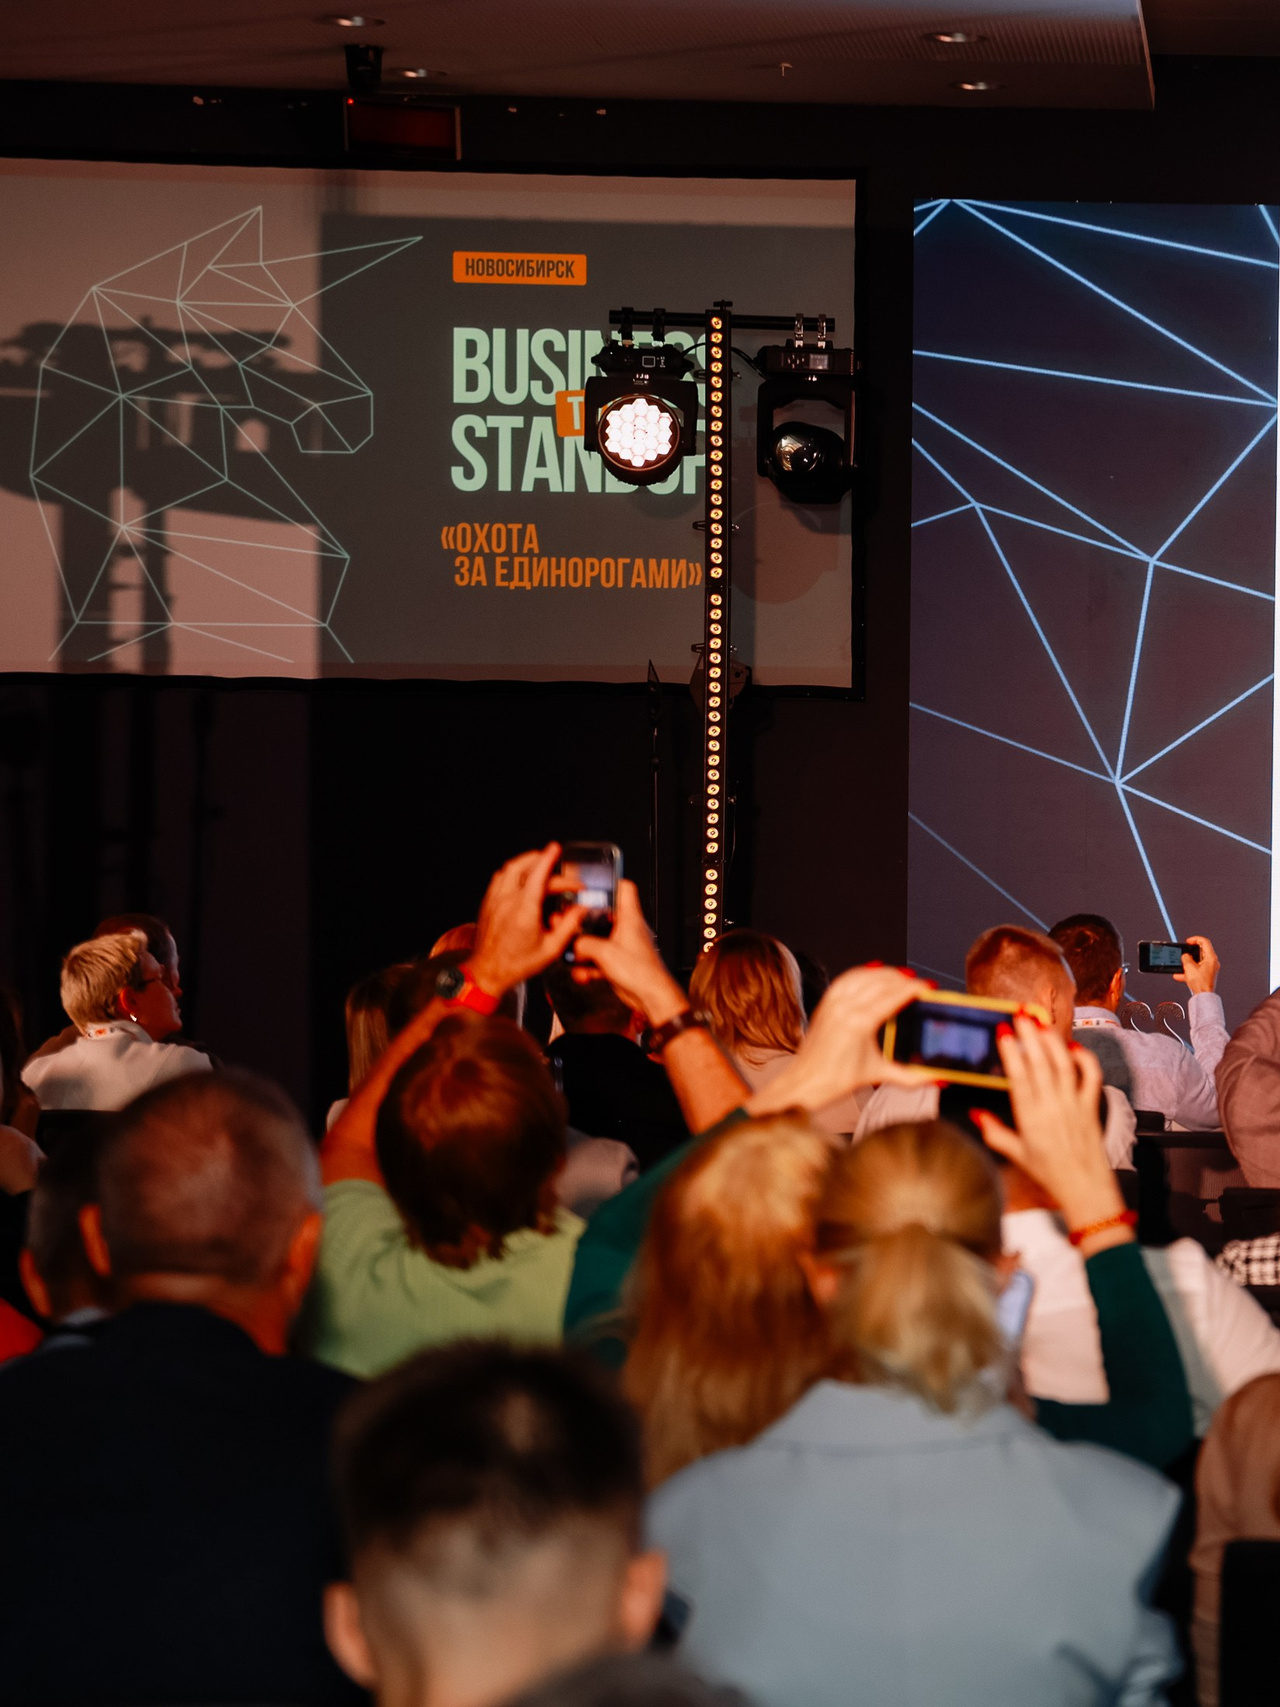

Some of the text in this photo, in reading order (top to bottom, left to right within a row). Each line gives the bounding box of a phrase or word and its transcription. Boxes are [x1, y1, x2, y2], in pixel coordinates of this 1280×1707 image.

[464, 257, 576, 279] НОВОСИБИРСК
[441, 522, 540, 554] «ОХОТА
[454, 556, 703, 590] ЗА ЕДИНОРОГАМИ»
